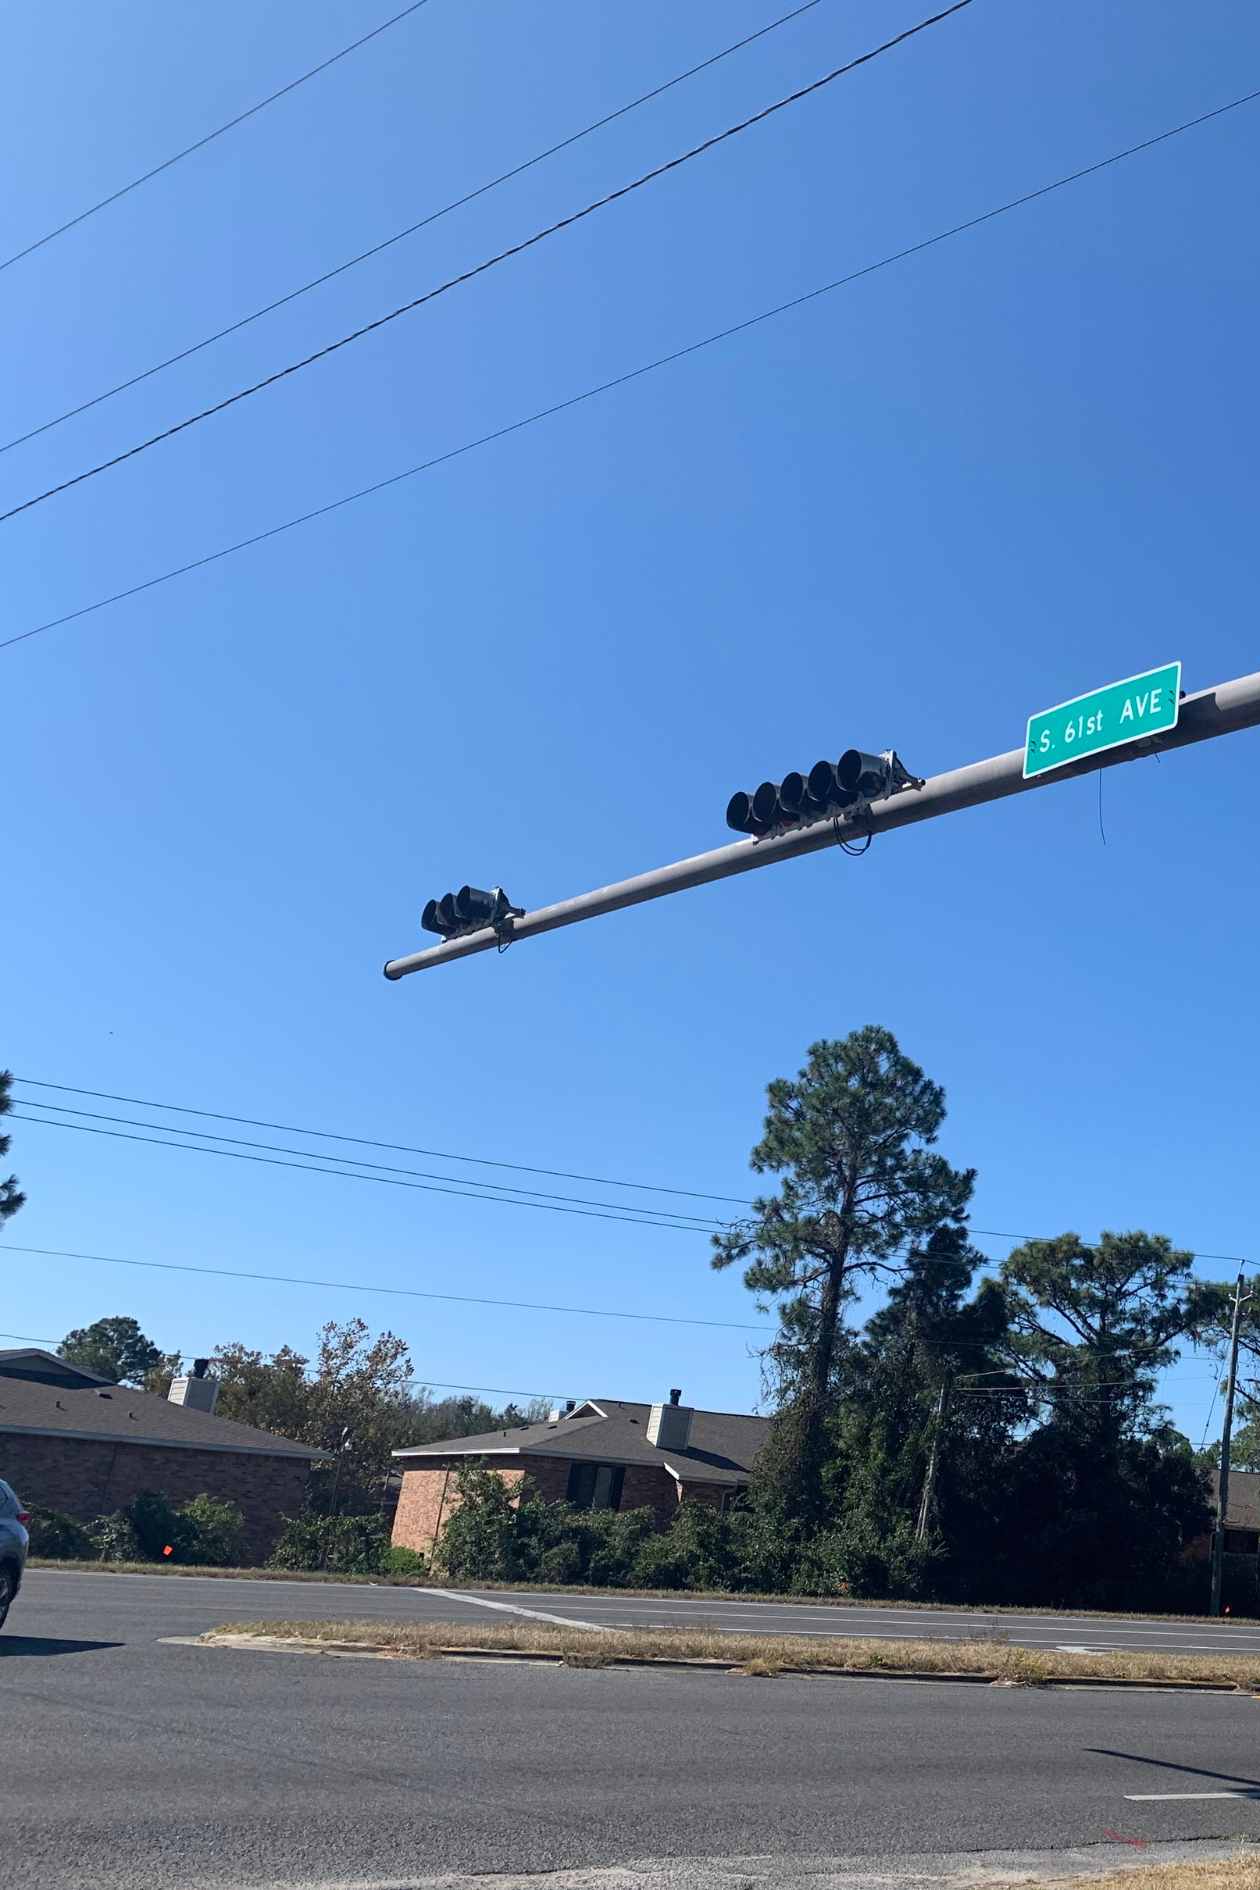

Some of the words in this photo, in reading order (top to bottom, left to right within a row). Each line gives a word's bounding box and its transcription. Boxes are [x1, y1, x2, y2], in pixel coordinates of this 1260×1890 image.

[1039, 729, 1056, 753] S.
[1064, 709, 1103, 743] 61st
[1119, 688, 1162, 724] AVE
